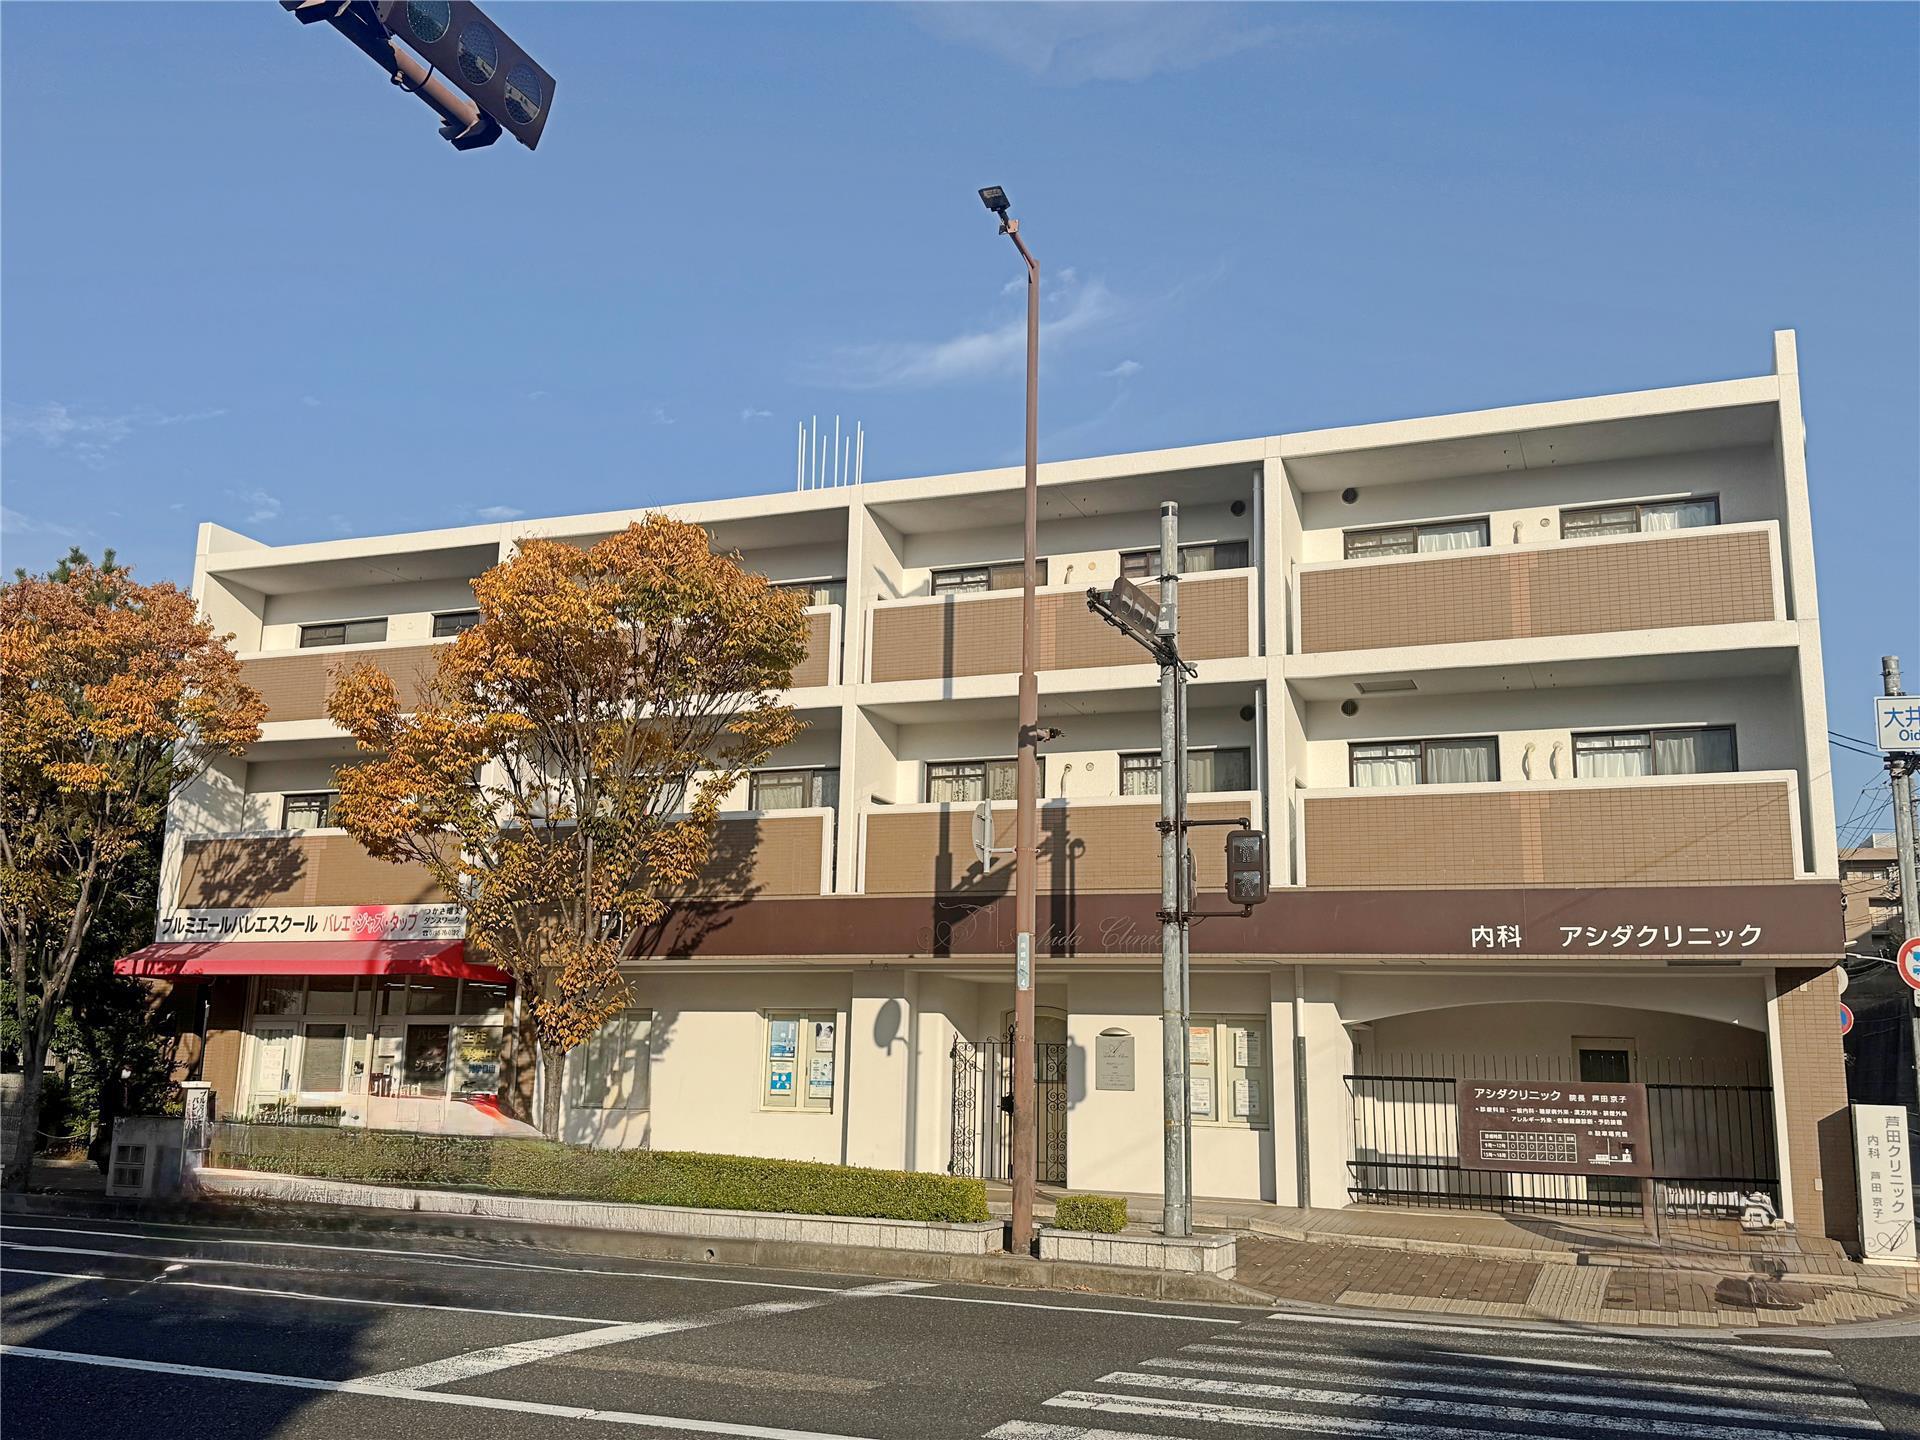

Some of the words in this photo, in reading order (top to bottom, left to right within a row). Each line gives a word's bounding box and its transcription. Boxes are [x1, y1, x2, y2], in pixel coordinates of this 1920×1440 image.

[162, 914, 318, 935] プルミエールバレエスクール
[1471, 925, 1522, 948] 内科
[1559, 924, 1763, 948] アシダクリニック
[1474, 1088, 1561, 1101] アシダクリニック
[1867, 1135, 1881, 1159] 内科
[1885, 1116, 1905, 1214] 芦田クリニック
